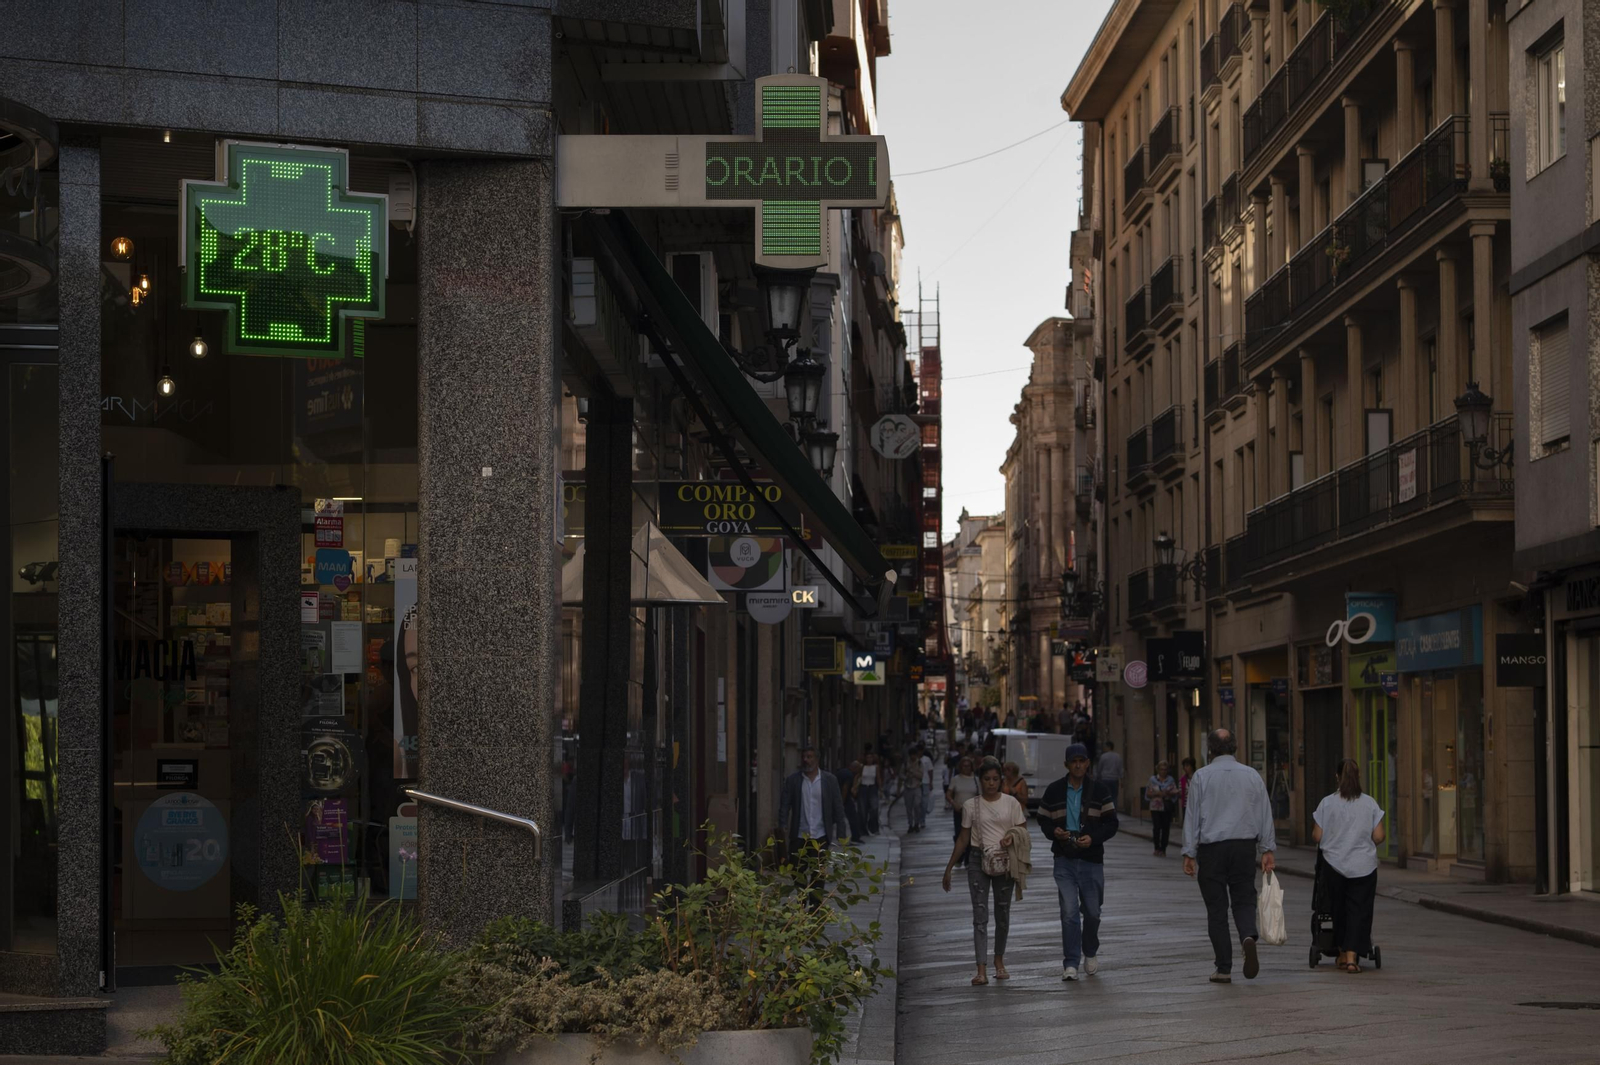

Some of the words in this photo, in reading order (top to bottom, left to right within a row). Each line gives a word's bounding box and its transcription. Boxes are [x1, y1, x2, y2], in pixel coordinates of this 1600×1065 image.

[703, 503, 756, 521] ORO
[316, 518, 342, 526] Alarma
[706, 521, 752, 534] GOYA
[318, 562, 347, 572] MAM
[1500, 655, 1546, 665] MANGO
